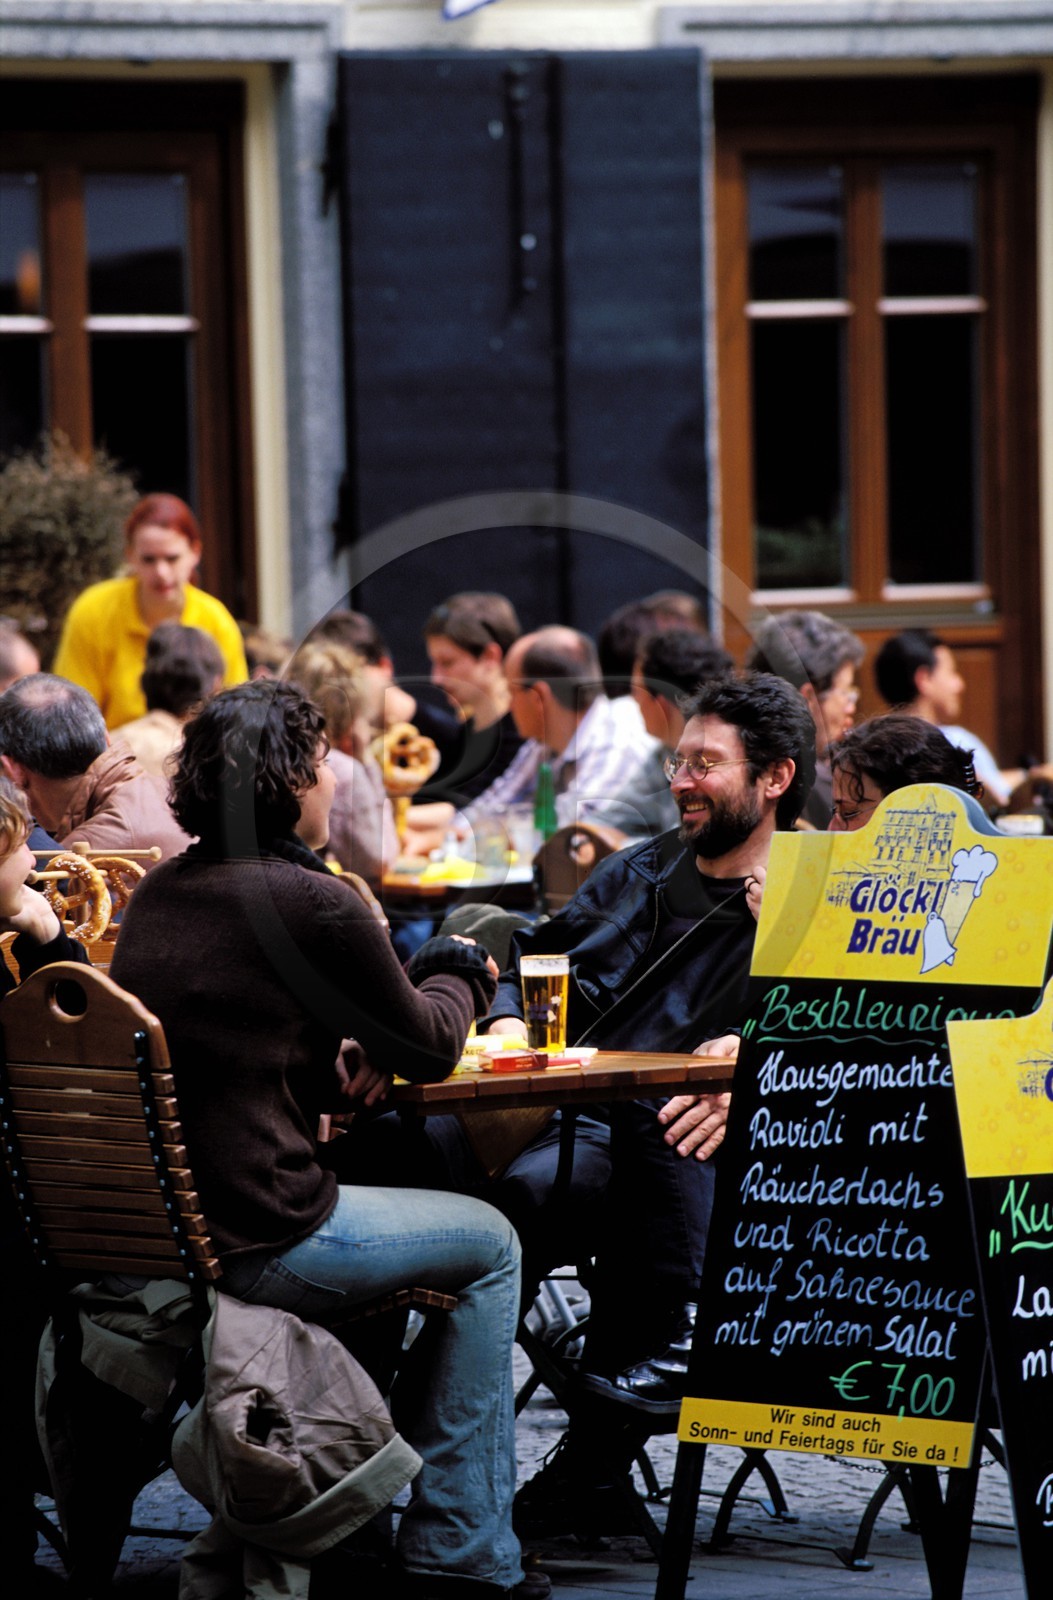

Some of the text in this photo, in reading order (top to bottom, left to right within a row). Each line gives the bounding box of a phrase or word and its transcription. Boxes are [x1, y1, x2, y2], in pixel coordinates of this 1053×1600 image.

[849, 874, 944, 914] Glöckl
[846, 915, 921, 955] Bräu
[757, 1049, 954, 1107] Hausgemachte
[749, 1102, 928, 1151] Ravioli mit
[740, 1161, 944, 1209] Räucherlachs
[734, 1215, 930, 1261] und Ricotta
[724, 1257, 975, 1319] auf Sahnesauce
[714, 1303, 957, 1360] mit grünem Salat
[689, 1421, 737, 1440] Sonn-
[744, 1428, 772, 1444] und
[779, 1430, 855, 1455] Feiertags
[863, 1437, 885, 1455] für
[891, 1440, 918, 1458] Sie
[771, 1408, 881, 1433] Wir sind auch
